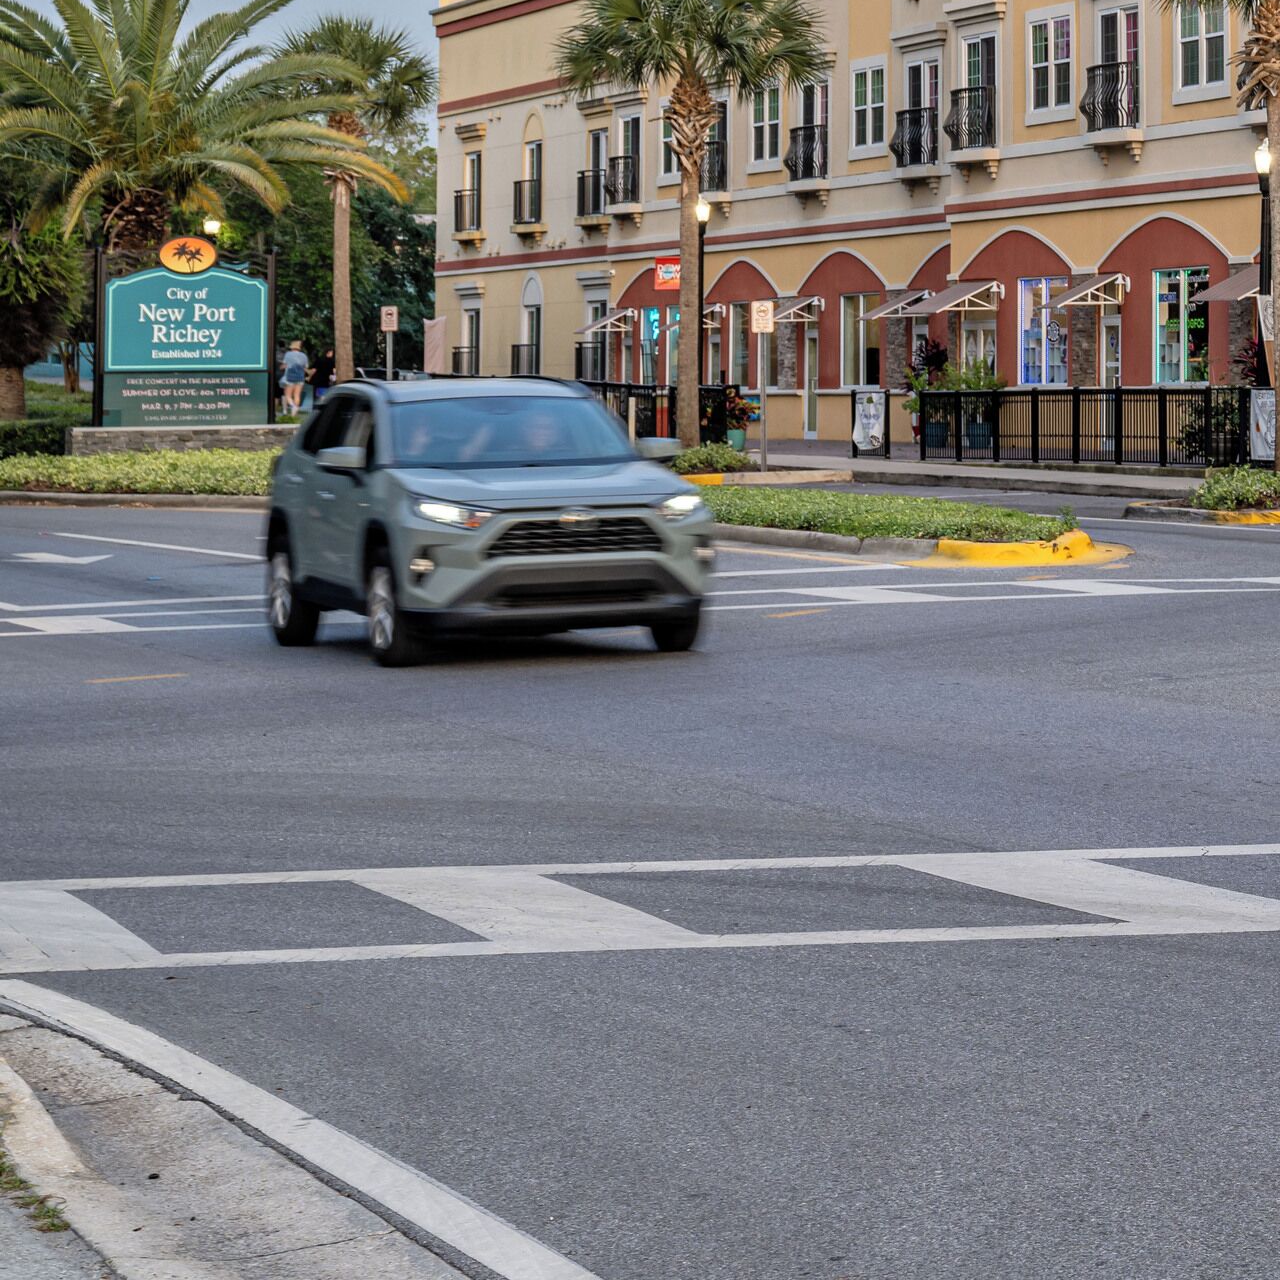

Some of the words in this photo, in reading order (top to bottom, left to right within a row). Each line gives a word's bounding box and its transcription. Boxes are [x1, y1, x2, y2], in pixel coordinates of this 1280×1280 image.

[657, 263, 681, 272] DOW
[166, 287, 192, 302] City
[194, 287, 208, 300] of
[138, 303, 186, 322] New
[193, 303, 236, 322] Port
[151, 323, 222, 348] Richey
[151, 349, 200, 359] Established
[201, 349, 222, 359] 1924
[126, 377, 143, 385] FREE
[145, 377, 178, 385] CONCERT
[121, 389, 158, 397] SUMMER
[159, 388, 171, 397] OF
[216, 387, 250, 396] TRIBUTE
[141, 402, 163, 410] MAR.
